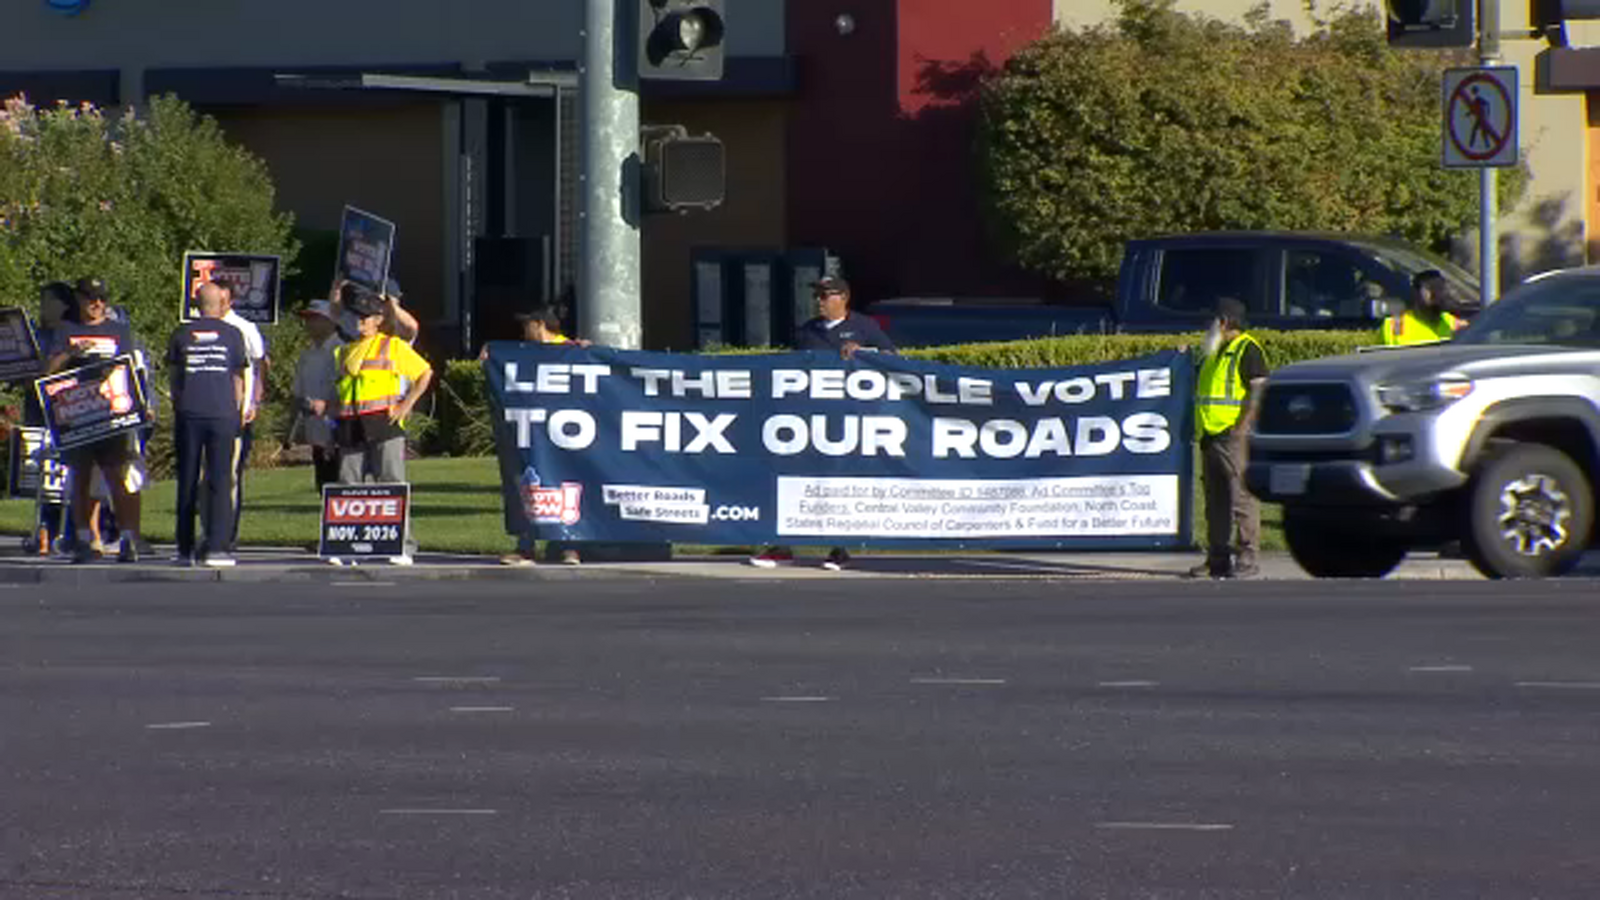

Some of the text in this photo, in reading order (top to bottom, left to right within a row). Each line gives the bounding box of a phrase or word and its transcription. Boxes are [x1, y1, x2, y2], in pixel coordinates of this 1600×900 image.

[504, 362, 1171, 406] LET THE PEOPLE VOTE
[504, 408, 1171, 458] TO FIX OUR ROADS
[607, 488, 696, 501] Better Roads
[872, 485, 887, 499] by
[330, 499, 397, 517] VOTE
[624, 505, 760, 521] Safe Streets .COM
[854, 502, 898, 514] Central
[902, 502, 938, 515] Valley
[942, 502, 1006, 516] Community
[1084, 501, 1118, 513] North
[1121, 500, 1157, 511] Coast
[826, 517, 880, 531] Regional
[882, 518, 928, 531] Council
[930, 519, 944, 530] of
[945, 518, 1011, 532] Carpenters
[1014, 517, 1024, 529] &
[1027, 516, 1058, 529] Fund
[1062, 516, 1078, 529] for
[1080, 519, 1089, 529] a
[1092, 516, 1127, 529] Better
[1131, 515, 1171, 529] Future
[327, 525, 398, 541] NOV. 2026
